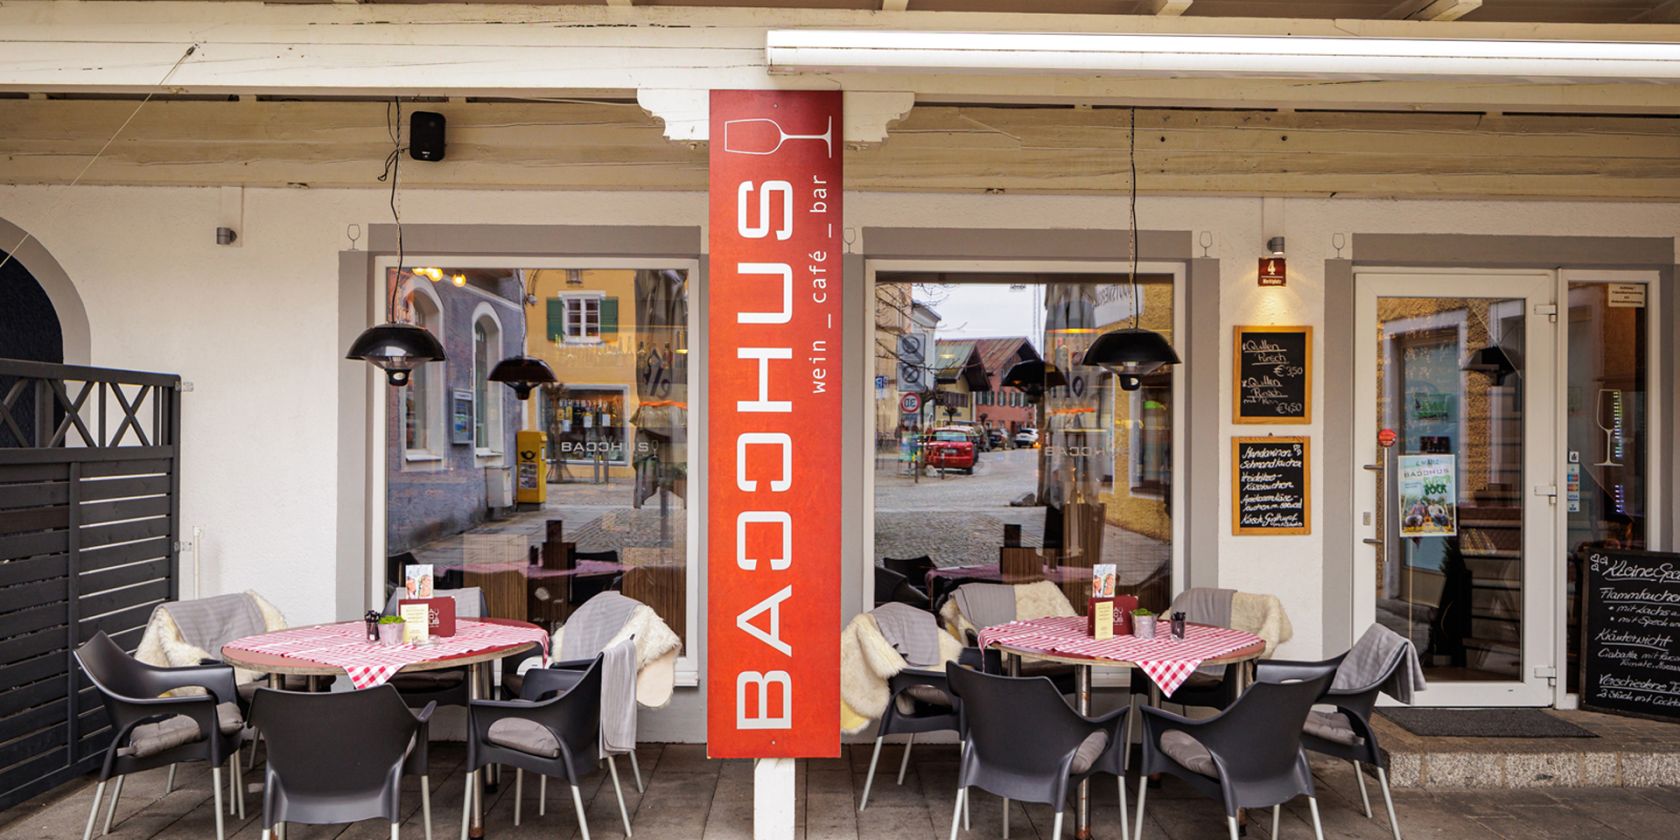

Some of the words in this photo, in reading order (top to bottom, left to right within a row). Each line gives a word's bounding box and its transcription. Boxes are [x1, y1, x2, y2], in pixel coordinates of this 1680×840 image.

[809, 175, 827, 213] bar
[808, 250, 827, 304] café
[1267, 260, 1276, 275] 4
[809, 340, 827, 394] wein
[561, 442, 649, 452] BACCHS
[737, 180, 793, 730] BACCHUS
[1602, 560, 1656, 578] Kleine
